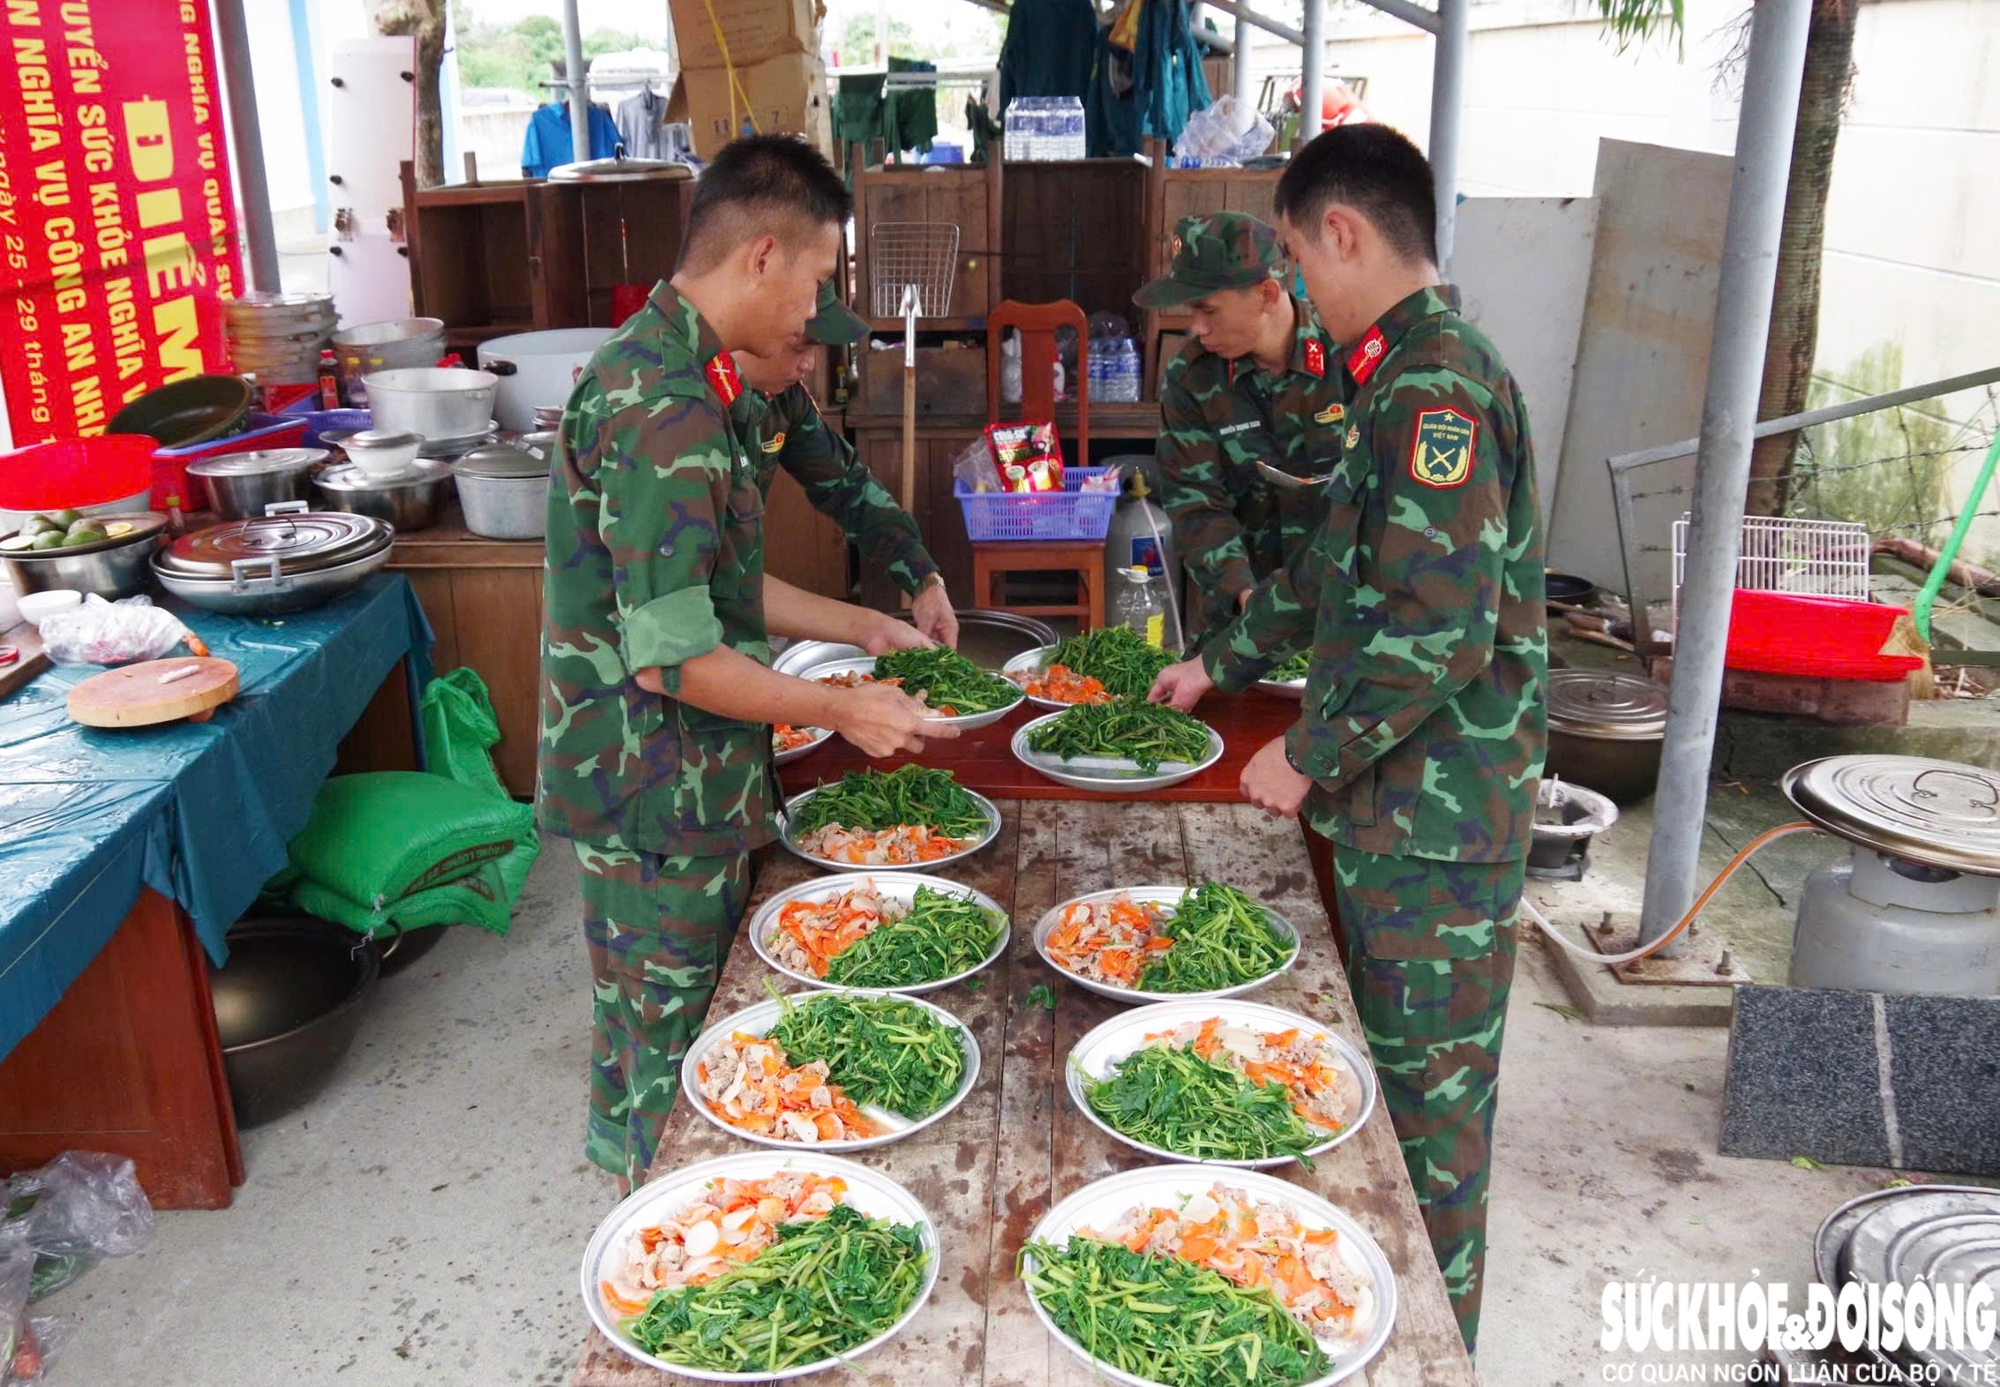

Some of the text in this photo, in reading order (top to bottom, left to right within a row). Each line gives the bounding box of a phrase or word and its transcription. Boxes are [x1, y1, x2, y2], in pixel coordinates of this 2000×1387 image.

[60, 0, 109, 94] UYỂN
[183, 33, 210, 125] NGHĨA
[12, 38, 64, 153] NGHĨA
[77, 104, 115, 173] SỨC
[197, 132, 216, 170] VỤ
[32, 160, 71, 206] VỤ
[203, 178, 227, 256] QUÂN
[5, 234, 28, 269] 25
[44, 216, 87, 314] CÔNG
[89, 182, 133, 270] KHỎE
[122, 94, 207, 386] ĐIỂM
[16, 298, 39, 332] 29
[60, 323, 97, 372] AN
[104, 276, 146, 380] NGHĨA
[24, 340, 50, 423] tháng
